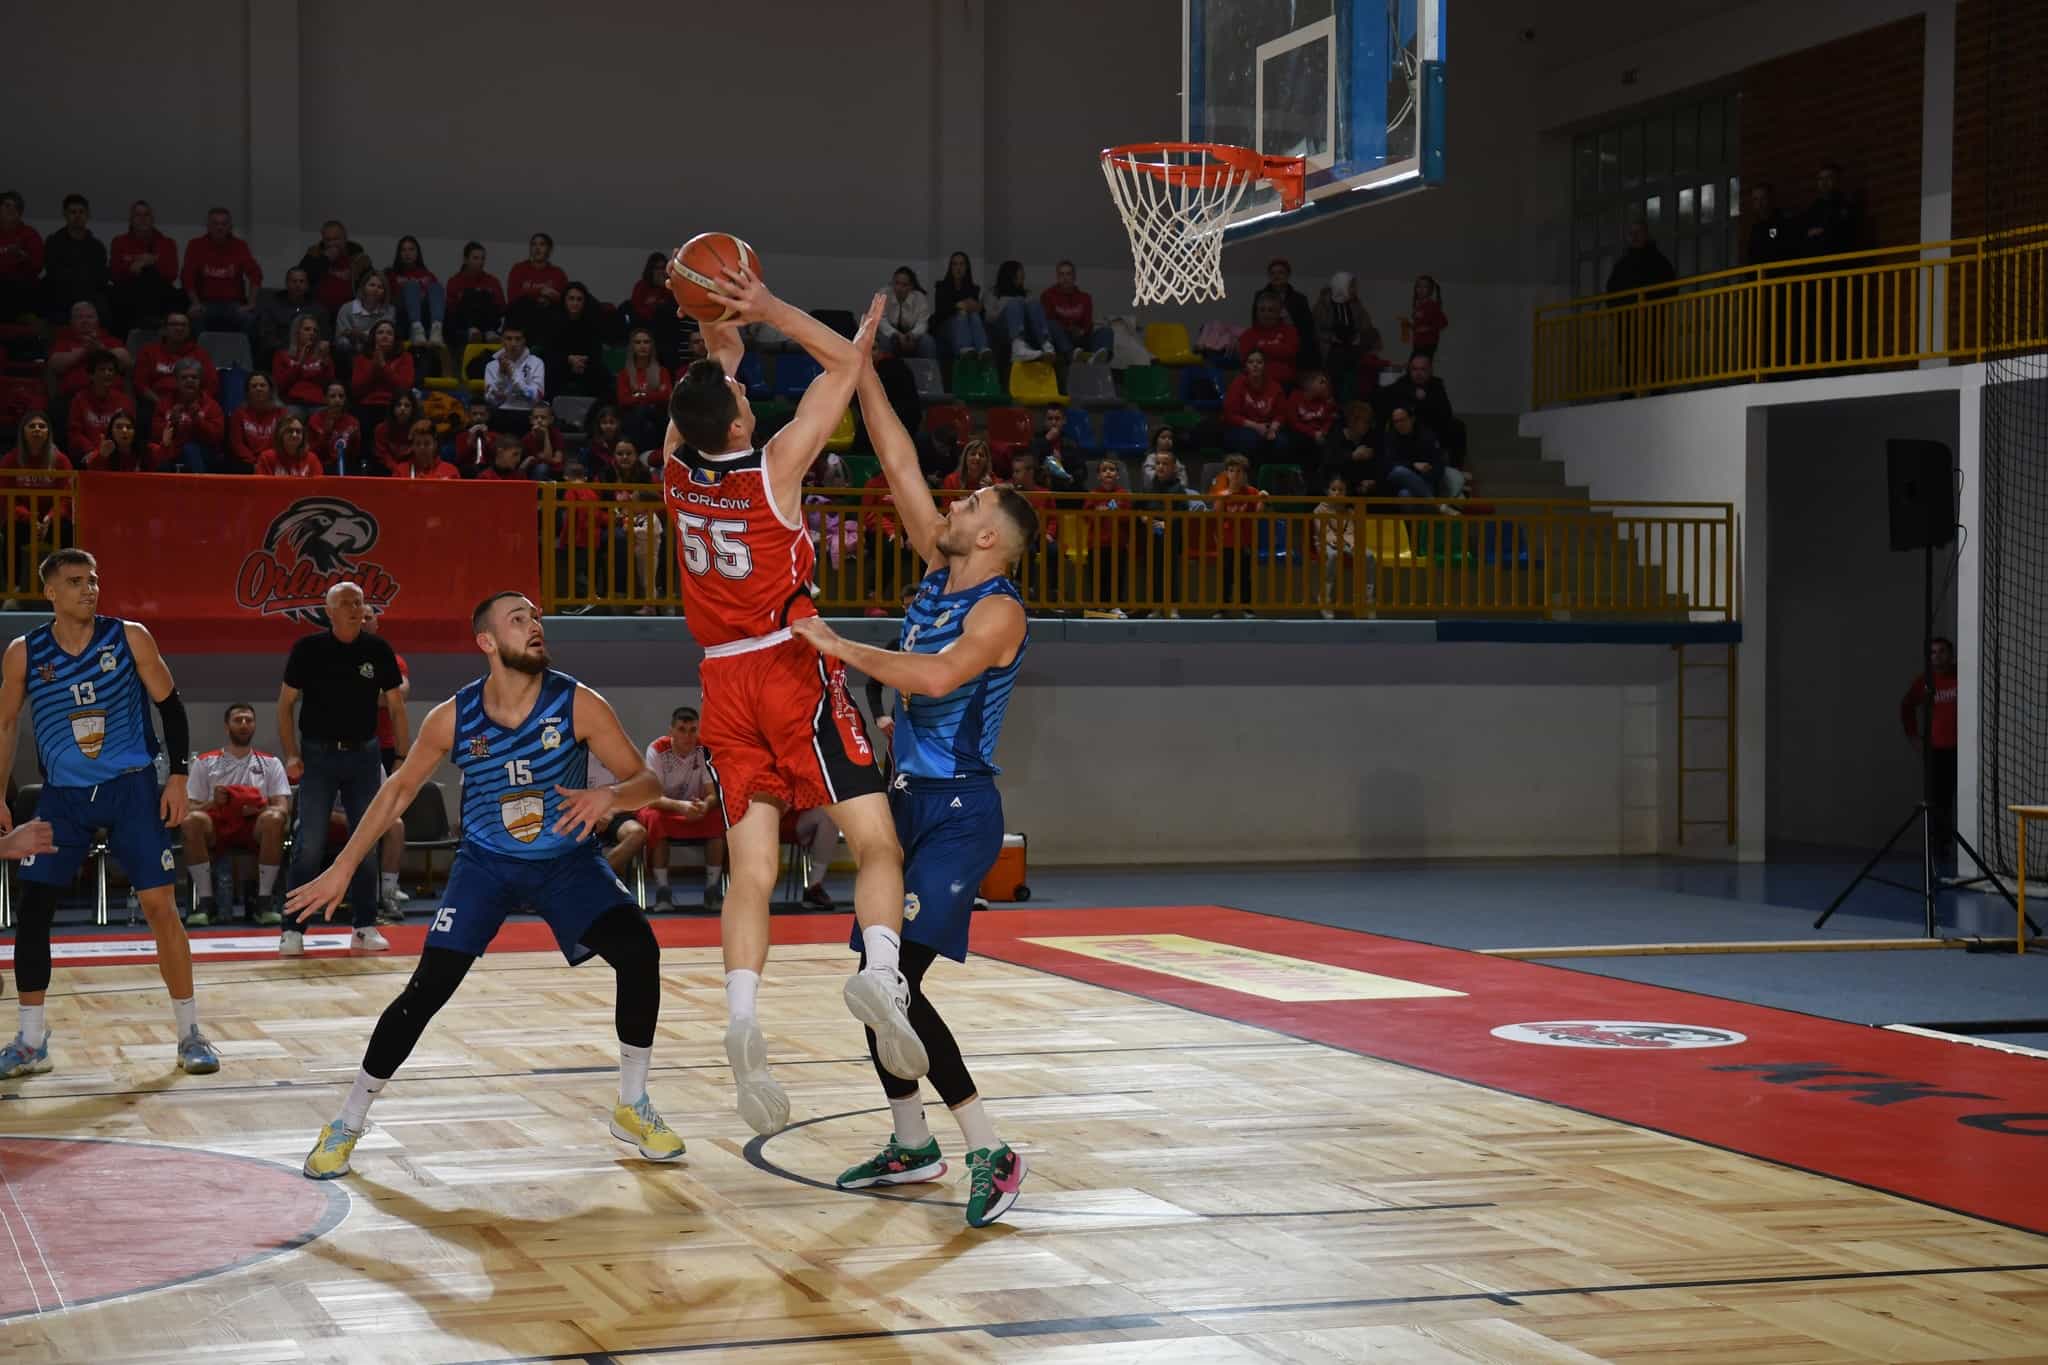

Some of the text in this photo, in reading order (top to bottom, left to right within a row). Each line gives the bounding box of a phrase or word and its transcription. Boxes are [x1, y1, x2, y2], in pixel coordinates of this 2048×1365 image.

[687, 492, 750, 509] ORLOVIK
[676, 509, 753, 579] 55
[69, 681, 97, 706] 13
[504, 759, 533, 786] 15
[430, 907, 457, 932] 15
